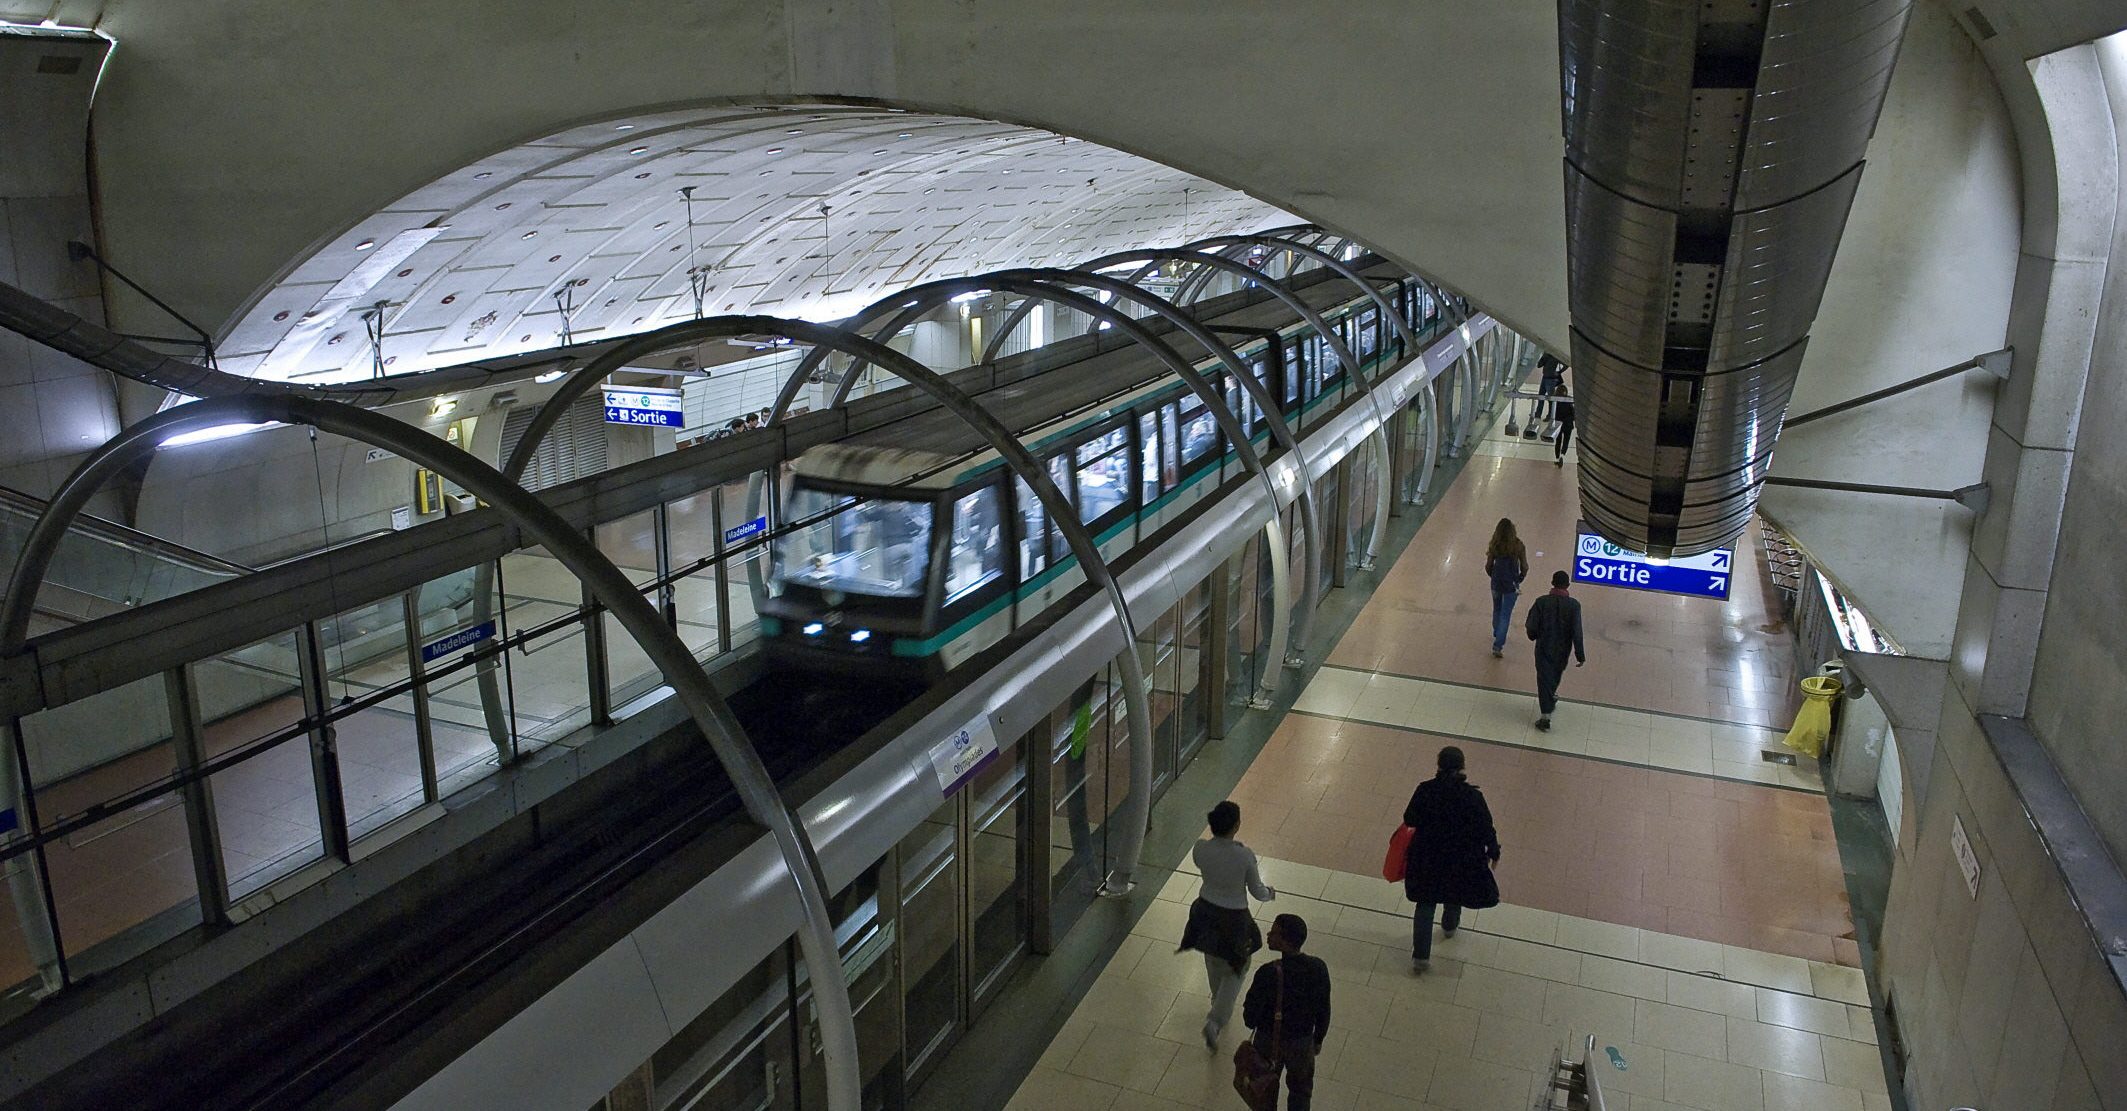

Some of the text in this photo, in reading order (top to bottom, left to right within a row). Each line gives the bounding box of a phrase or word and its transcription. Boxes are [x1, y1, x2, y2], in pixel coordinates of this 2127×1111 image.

[631, 410, 667, 424] Sortie
[727, 523, 757, 541] Madeleine
[1604, 542, 1619, 555] 12
[1578, 558, 1650, 584] Sortie
[432, 629, 481, 656] Madeleine
